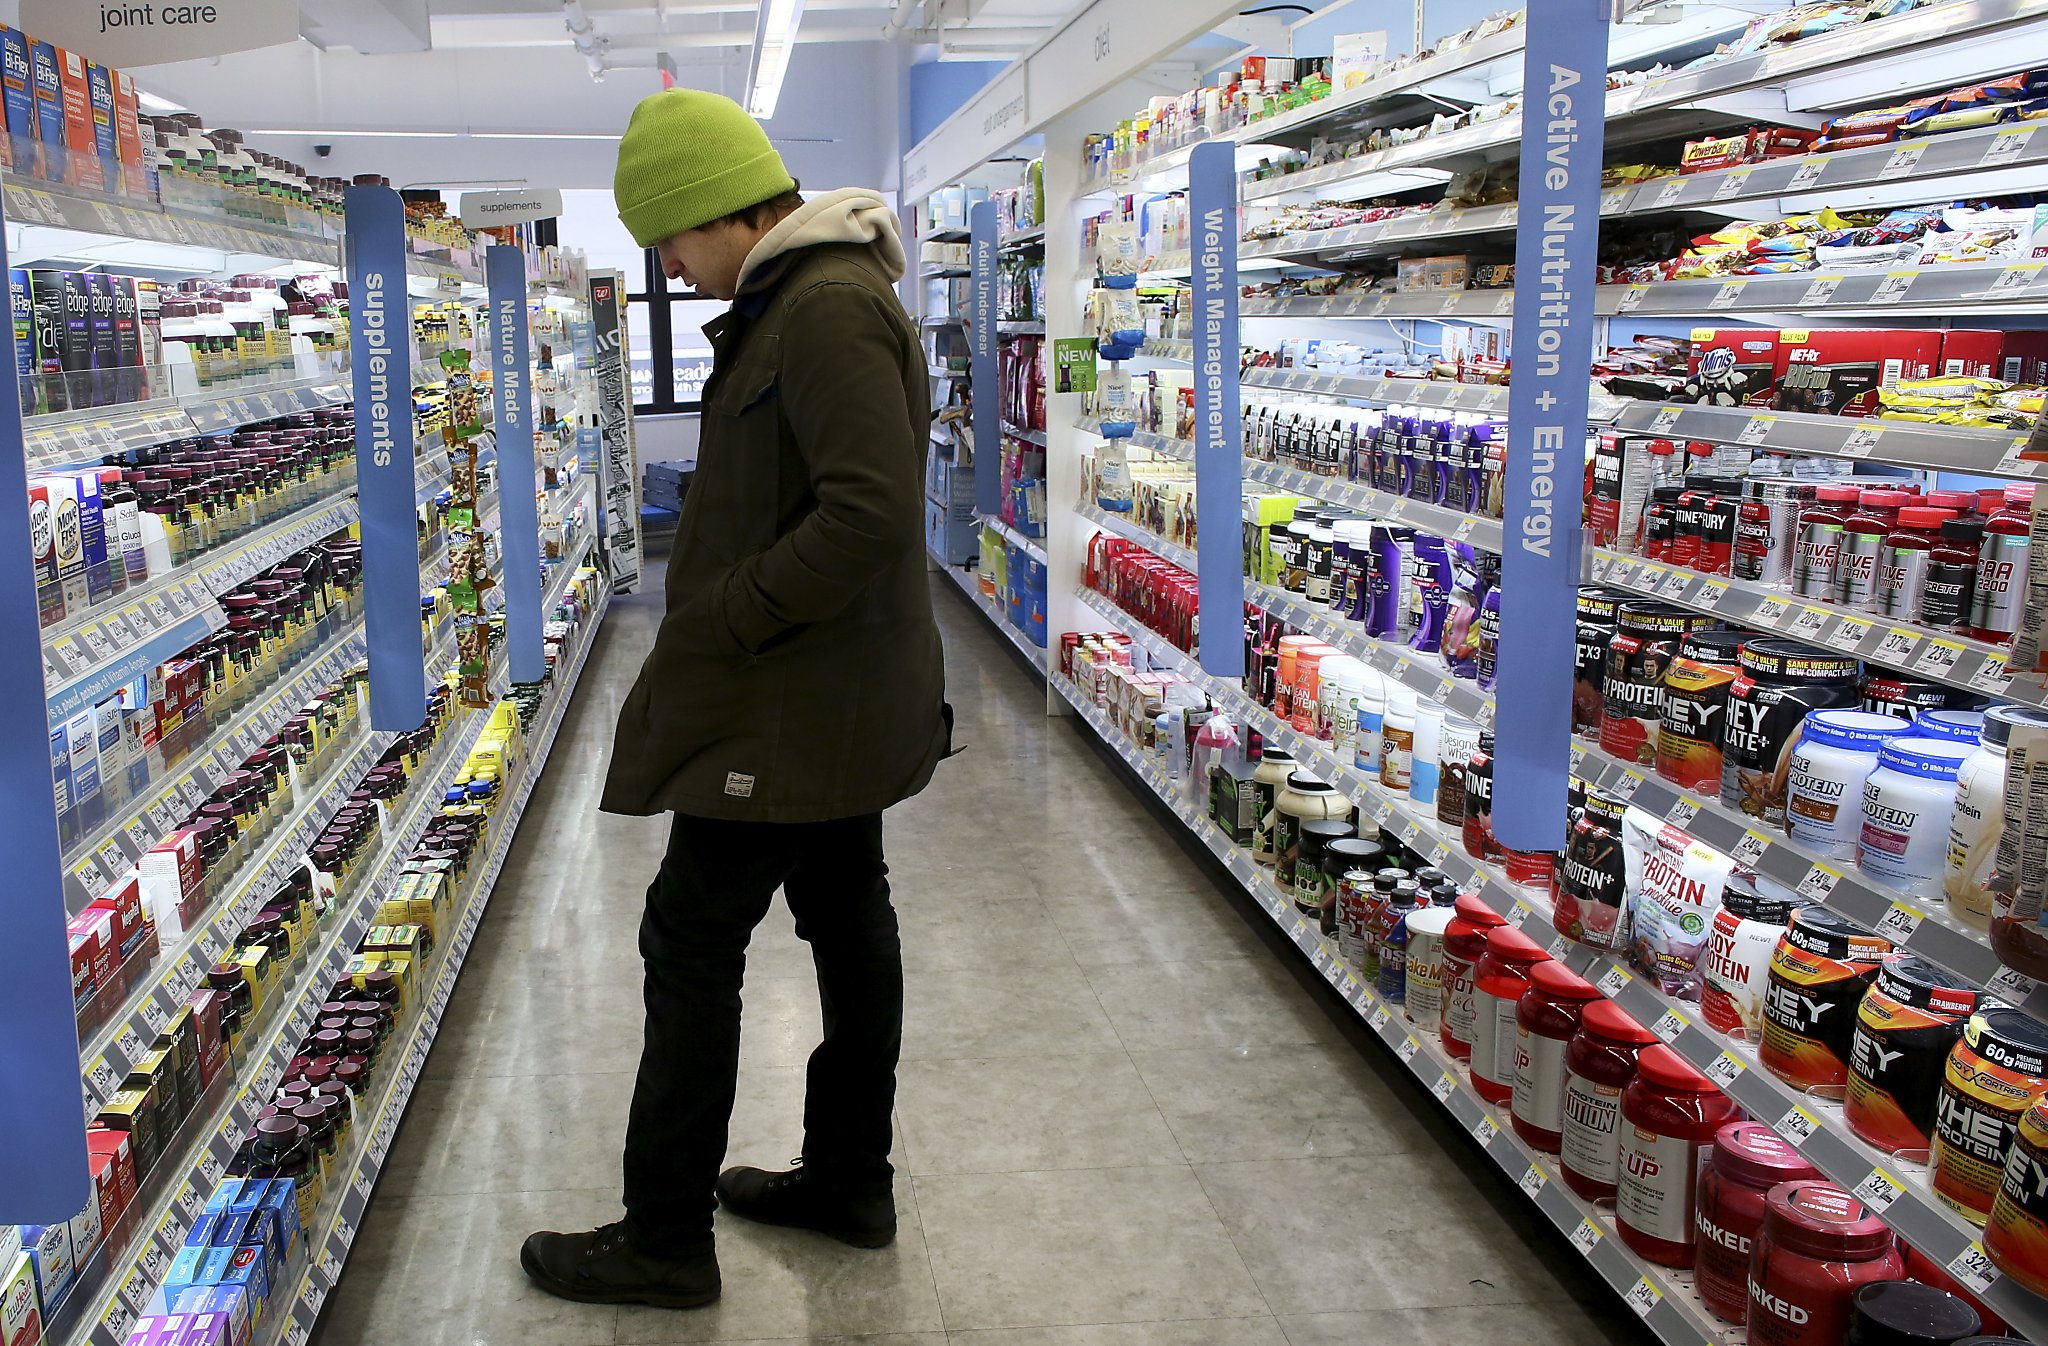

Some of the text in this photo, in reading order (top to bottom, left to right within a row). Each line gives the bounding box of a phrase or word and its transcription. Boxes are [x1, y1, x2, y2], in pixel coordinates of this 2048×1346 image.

[100, 4, 217, 33] joint care
[1546, 63, 1581, 190] Active
[1688, 141, 1728, 159] PowerBar
[480, 200, 542, 214] supplements
[10, 281, 24, 294] steo
[1535, 205, 1574, 376] Nutrition
[67, 290, 89, 317] edge
[92, 291, 113, 318] edge
[116, 292, 136, 319] edge
[977, 239, 990, 358] Adult Underwear
[1200, 207, 1229, 449] Weight Management
[500, 299, 520, 424] Nature Made
[1058, 350, 1094, 363] NEW
[1701, 348, 1734, 374] Minis
[1789, 349, 1820, 362] MET-Rx
[362, 273, 394, 467] supplements
[1595, 454, 1620, 471] VITAMIN
[614, 483, 627, 520] corner
[1522, 425, 1564, 557] Energy
[57, 506, 77, 532] Move
[61, 522, 77, 547] Free
[617, 521, 629, 540] the
[1804, 556, 1834, 568] MAN
[1881, 564, 1908, 581] TIVE
[1842, 567, 1871, 580] MAN
[1977, 578, 2009, 593] 2200
[1630, 621, 1685, 633] COMPACT BOTTLE
[1633, 614, 1685, 627] WEIGHT VALUE
[233, 665, 241, 679] C
[1786, 660, 1837, 671] SAME WEIGHT
[1786, 667, 1841, 677] NEW COMPACT
[61, 688, 82, 719] proud
[106, 664, 130, 685] Vitamin
[215, 683, 223, 695] C
[1295, 686, 1310, 699] EAN
[1661, 694, 1722, 726] HEY
[1726, 695, 1770, 734] HEY
[1661, 720, 1696, 736] OTEIN
[1855, 732, 1868, 740] White
[1382, 738, 1397, 753] Soy
[1444, 732, 1479, 751] Designe
[1929, 764, 1943, 773] White
[1788, 769, 1845, 797] PROTEIN
[1658, 849, 1685, 870] INSTANT
[1643, 851, 1706, 907] PROTEIN
[1639, 877, 1684, 918] Smoothie
[1709, 929, 1736, 958] SOY
[1748, 933, 1772, 944] NEW!
[1790, 928, 1829, 949] 60g PREMIUM
[1807, 941, 1830, 955] PROTEIN
[1847, 943, 1878, 954] CHOCOLATE
[1656, 952, 1675, 964] Tastes
[1784, 957, 1820, 976] FORTRESS
[1890, 986, 1913, 1002] PROTEIN
[1891, 980, 1912, 994] PREMIUM
[1765, 978, 1836, 1025] HEY
[1928, 996, 1972, 1013] STRAWBERRY
[1851, 1026, 1905, 1072] HEY
[1985, 1042, 2043, 1068] 60g PREMIUM
[2014, 1059, 2043, 1074] PROTEIN
[1979, 1074, 2030, 1099] FORTRESS
[1568, 1085, 1618, 1111] PROTEIN
[1565, 1091, 1617, 1135] UTION
[1960, 1094, 2019, 1124] ADVANCE
[1936, 1119, 2009, 1165] PROTEIN
[1626, 1159, 1661, 1180] UP
[2002, 1171, 2030, 1206] TEIN
[1936, 1191, 1962, 1213] VANILLA
